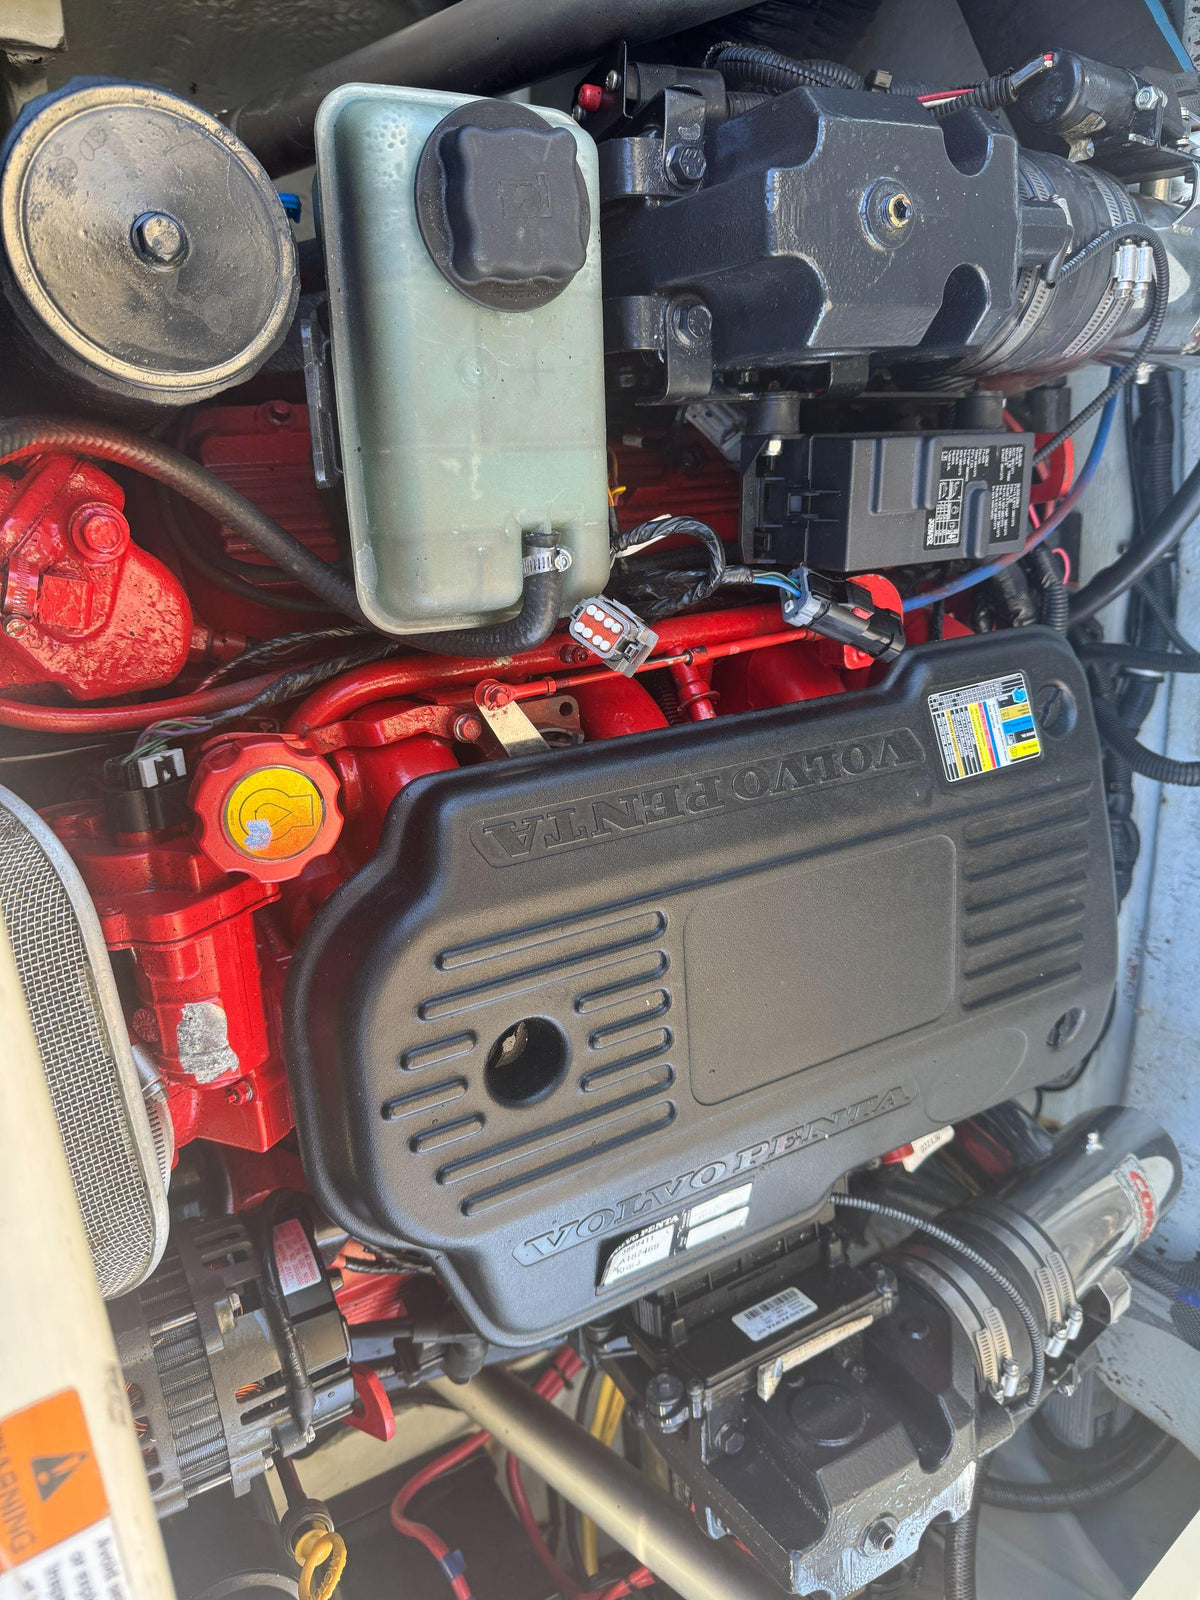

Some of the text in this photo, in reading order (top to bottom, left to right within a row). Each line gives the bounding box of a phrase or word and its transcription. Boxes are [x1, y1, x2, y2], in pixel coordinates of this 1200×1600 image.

[732, 738, 913, 800] VOLVO
[483, 774, 725, 858] PENTA
[525, 1160, 727, 1257] VOLVO
[732, 1085, 911, 1173] PENTA
[640, 1214, 679, 1237] PENTA
